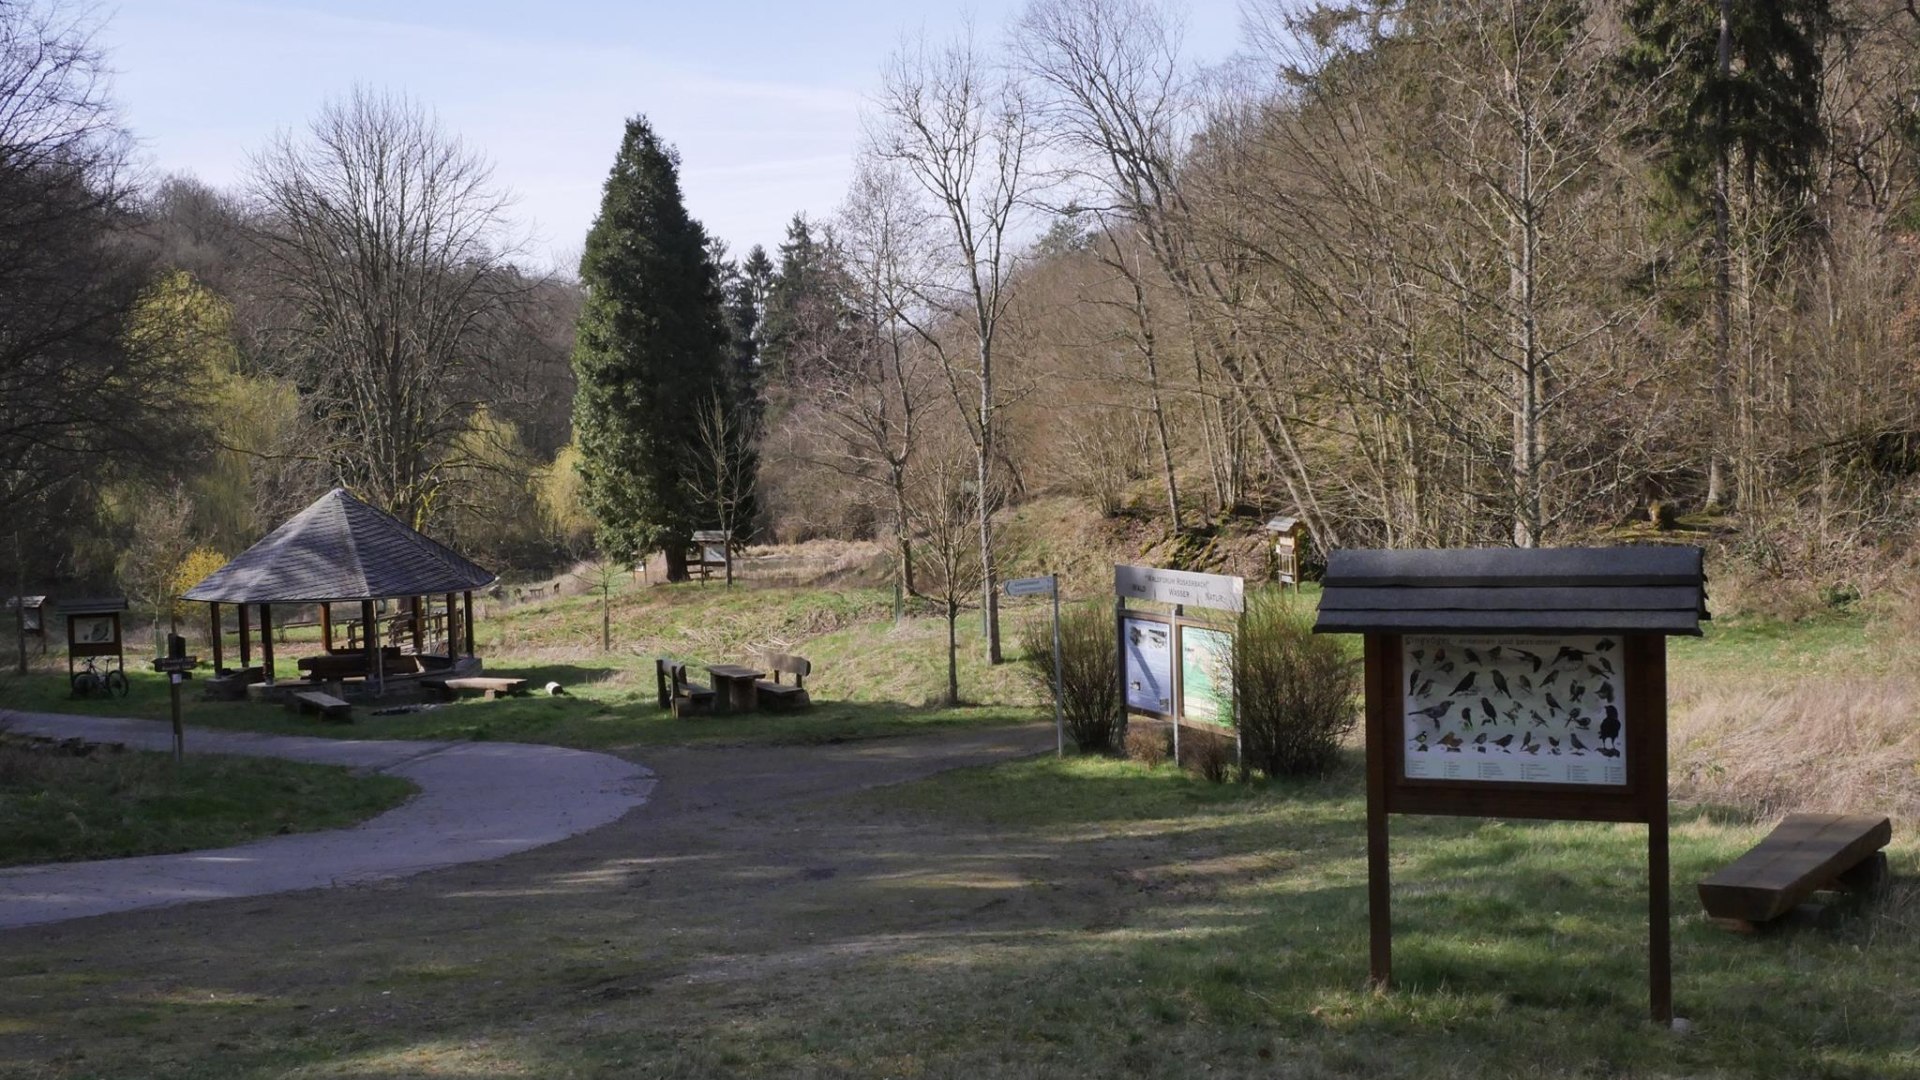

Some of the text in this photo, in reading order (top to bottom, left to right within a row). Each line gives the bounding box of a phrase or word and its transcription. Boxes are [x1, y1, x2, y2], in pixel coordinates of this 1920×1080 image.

[1132, 584, 1224, 602] WALD WASSER NATUR
